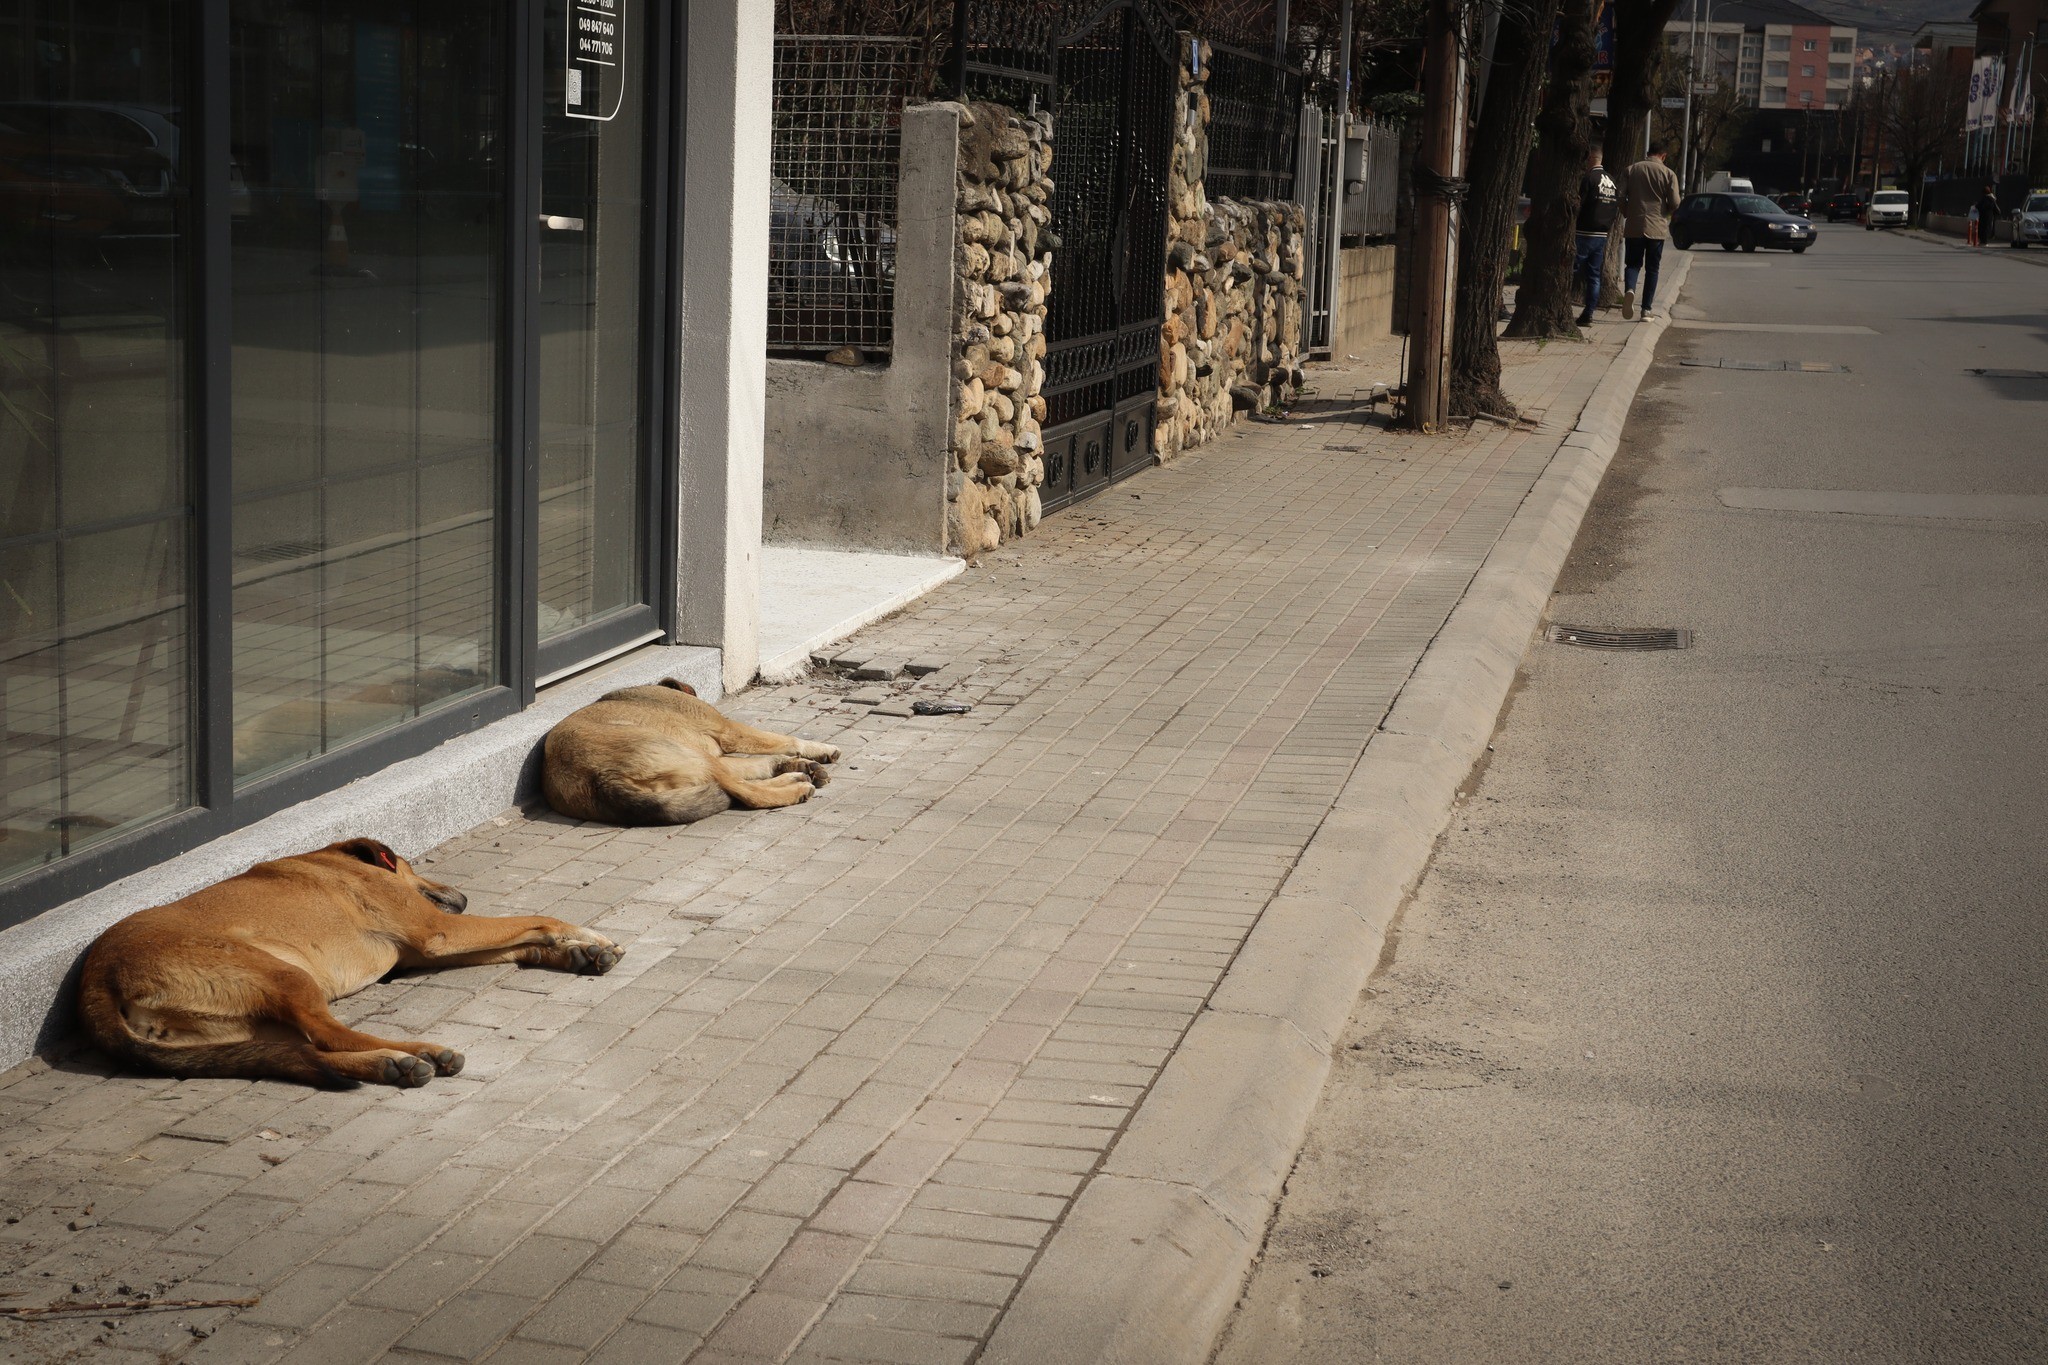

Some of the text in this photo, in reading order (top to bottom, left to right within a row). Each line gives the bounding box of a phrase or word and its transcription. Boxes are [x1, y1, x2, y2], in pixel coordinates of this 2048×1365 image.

[579, 17, 614, 36] 049 847 640
[579, 37, 613, 55] 044 771 706
